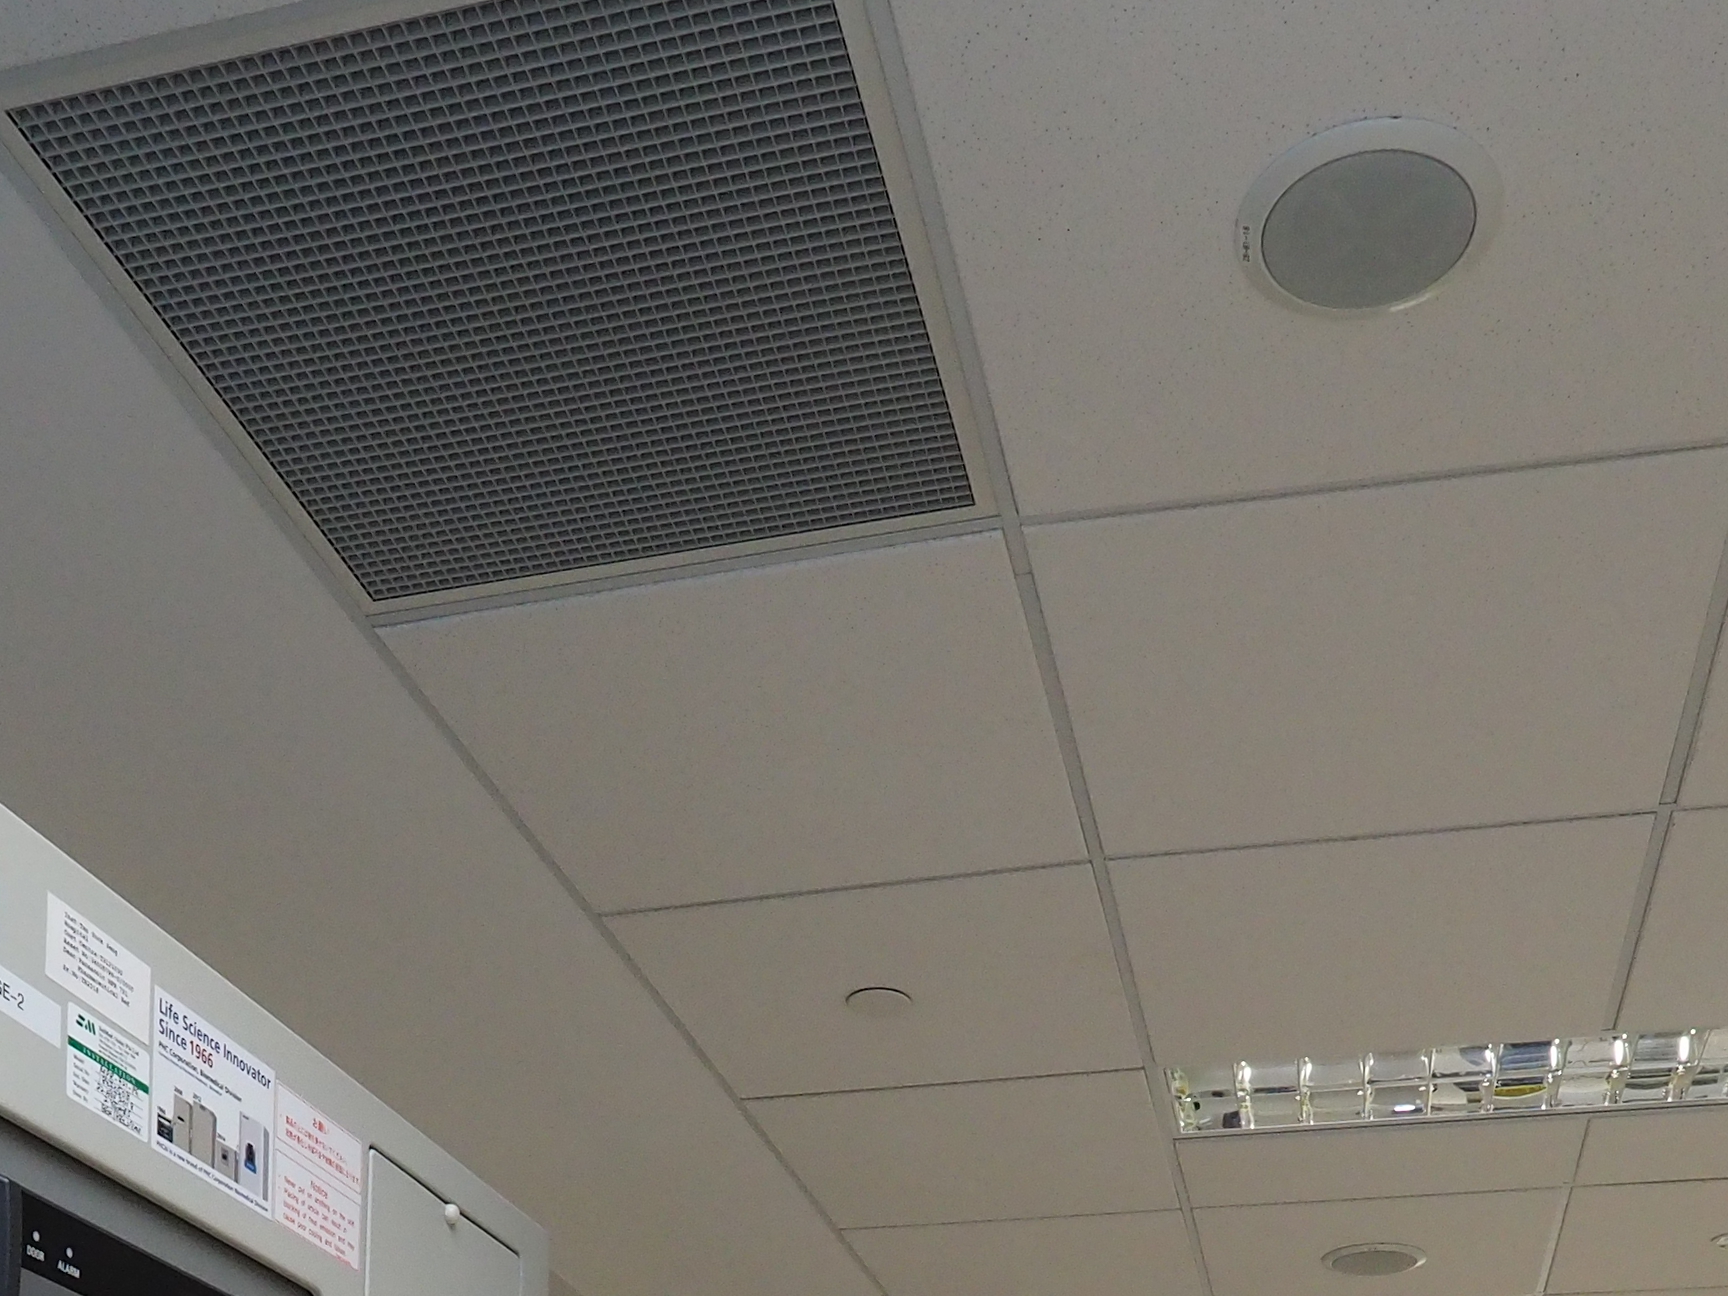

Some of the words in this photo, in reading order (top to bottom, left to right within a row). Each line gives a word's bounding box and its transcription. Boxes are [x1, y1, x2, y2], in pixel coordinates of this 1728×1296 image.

[158, 1018, 187, 1051] Since
[189, 1040, 214, 1069] 1966
[159, 997, 179, 1025] Life
[182, 1015, 221, 1054] Science
[223, 1043, 271, 1090] Innovator
[82, 1046, 137, 1085] INSTALLATION
[26, 1244, 45, 1262] DOOR
[57, 1259, 80, 1279] ALARM
